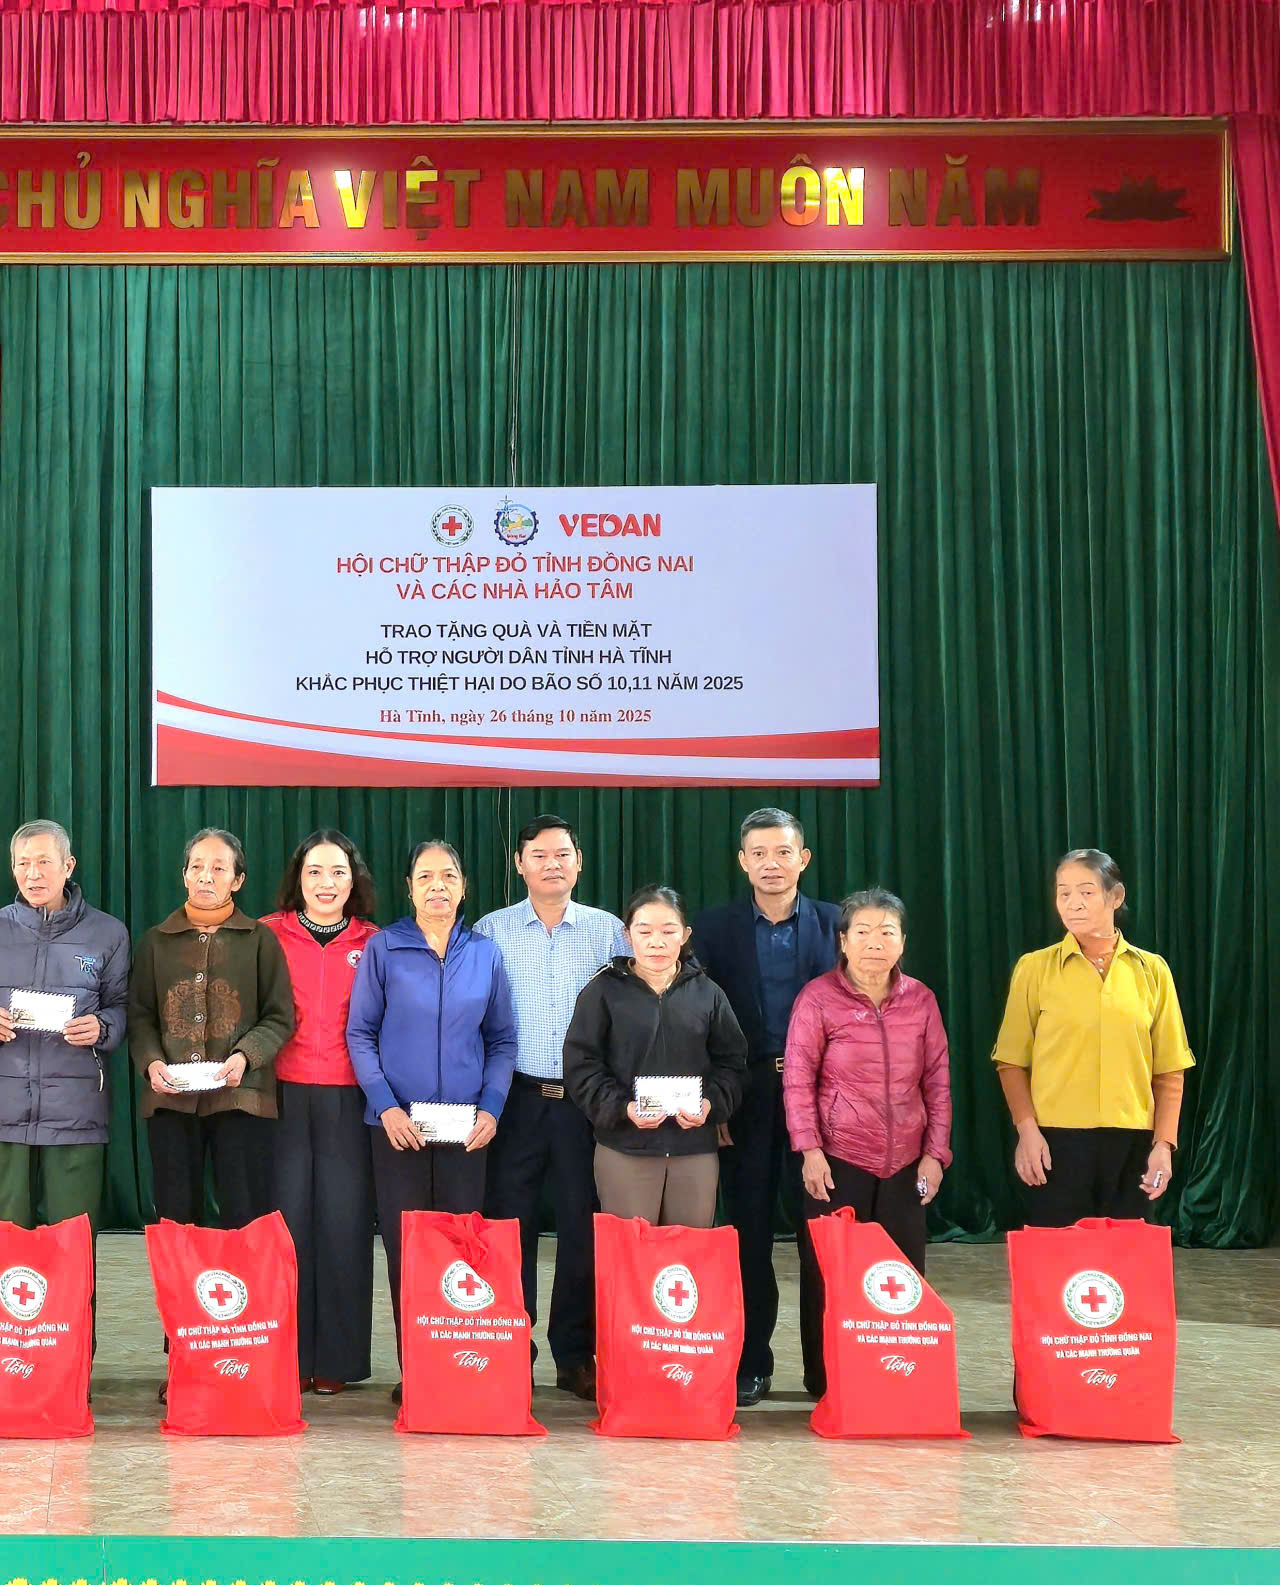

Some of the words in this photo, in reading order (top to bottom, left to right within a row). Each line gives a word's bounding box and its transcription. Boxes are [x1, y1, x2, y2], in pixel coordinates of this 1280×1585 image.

[124, 156, 321, 229] NGHĨA
[333, 155, 481, 240] VIỆT
[505, 167, 650, 227] NAM
[674, 152, 865, 227] MUÔN
[887, 152, 1042, 227] NĂM
[558, 513, 661, 537] VEDAN
[338, 553, 373, 576] HỘI
[380, 553, 428, 573] CHỮ
[433, 553, 490, 576] THẬP
[495, 552, 527, 572] ĐỎ
[533, 552, 581, 572] TỈNH
[587, 552, 651, 572] ĐỒNG
[658, 556, 693, 571] NAI
[397, 579, 425, 599] VÀ
[432, 579, 476, 599] CÁC
[484, 579, 528, 599] NHÀ
[535, 578, 581, 598] HẢO
[587, 578, 632, 598] TÂM
[381, 625, 431, 638] TRAO
[436, 621, 487, 641] TẶNG
[493, 620, 532, 641] QUÀ
[537, 620, 561, 637] VÀ
[567, 620, 607, 637] TIỀN
[613, 620, 652, 640] MẶT
[367, 647, 392, 664] HỖ
[397, 651, 437, 667] TRỢ
[443, 647, 503, 664] NGƯỜI
[509, 647, 547, 664] DÂN
[552, 646, 593, 664] TỈNH
[600, 646, 624, 663] HÀ
[630, 647, 671, 663] TĨNH
[297, 673, 347, 690] KHẮC
[353, 677, 403, 693] PHỤC
[408, 673, 459, 693] THIỆT
[465, 677, 494, 693] HẠI
[501, 677, 526, 690] DO
[532, 673, 571, 690] BÃO
[577, 673, 602, 690] SỐ
[608, 676, 652, 693] 10,11
[658, 673, 697, 690] NĂM
[703, 676, 743, 690] 2025
[381, 710, 402, 723] Hà
[407, 709, 446, 725] Tĩnh,
[451, 710, 484, 725] ngày
[491, 710, 506, 722] 26
[512, 709, 553, 725] tháng
[561, 710, 575, 722] 10
[581, 710, 611, 722] năm
[618, 710, 651, 722] 2025
[1, 1357, 34, 1378] Tặng
[214, 1358, 250, 1379] Tặng
[454, 1351, 489, 1372] Tặng
[881, 1355, 916, 1376] Tặng
[662, 1364, 693, 1386] Tặng
[1081, 1368, 1117, 1388] Tặng
